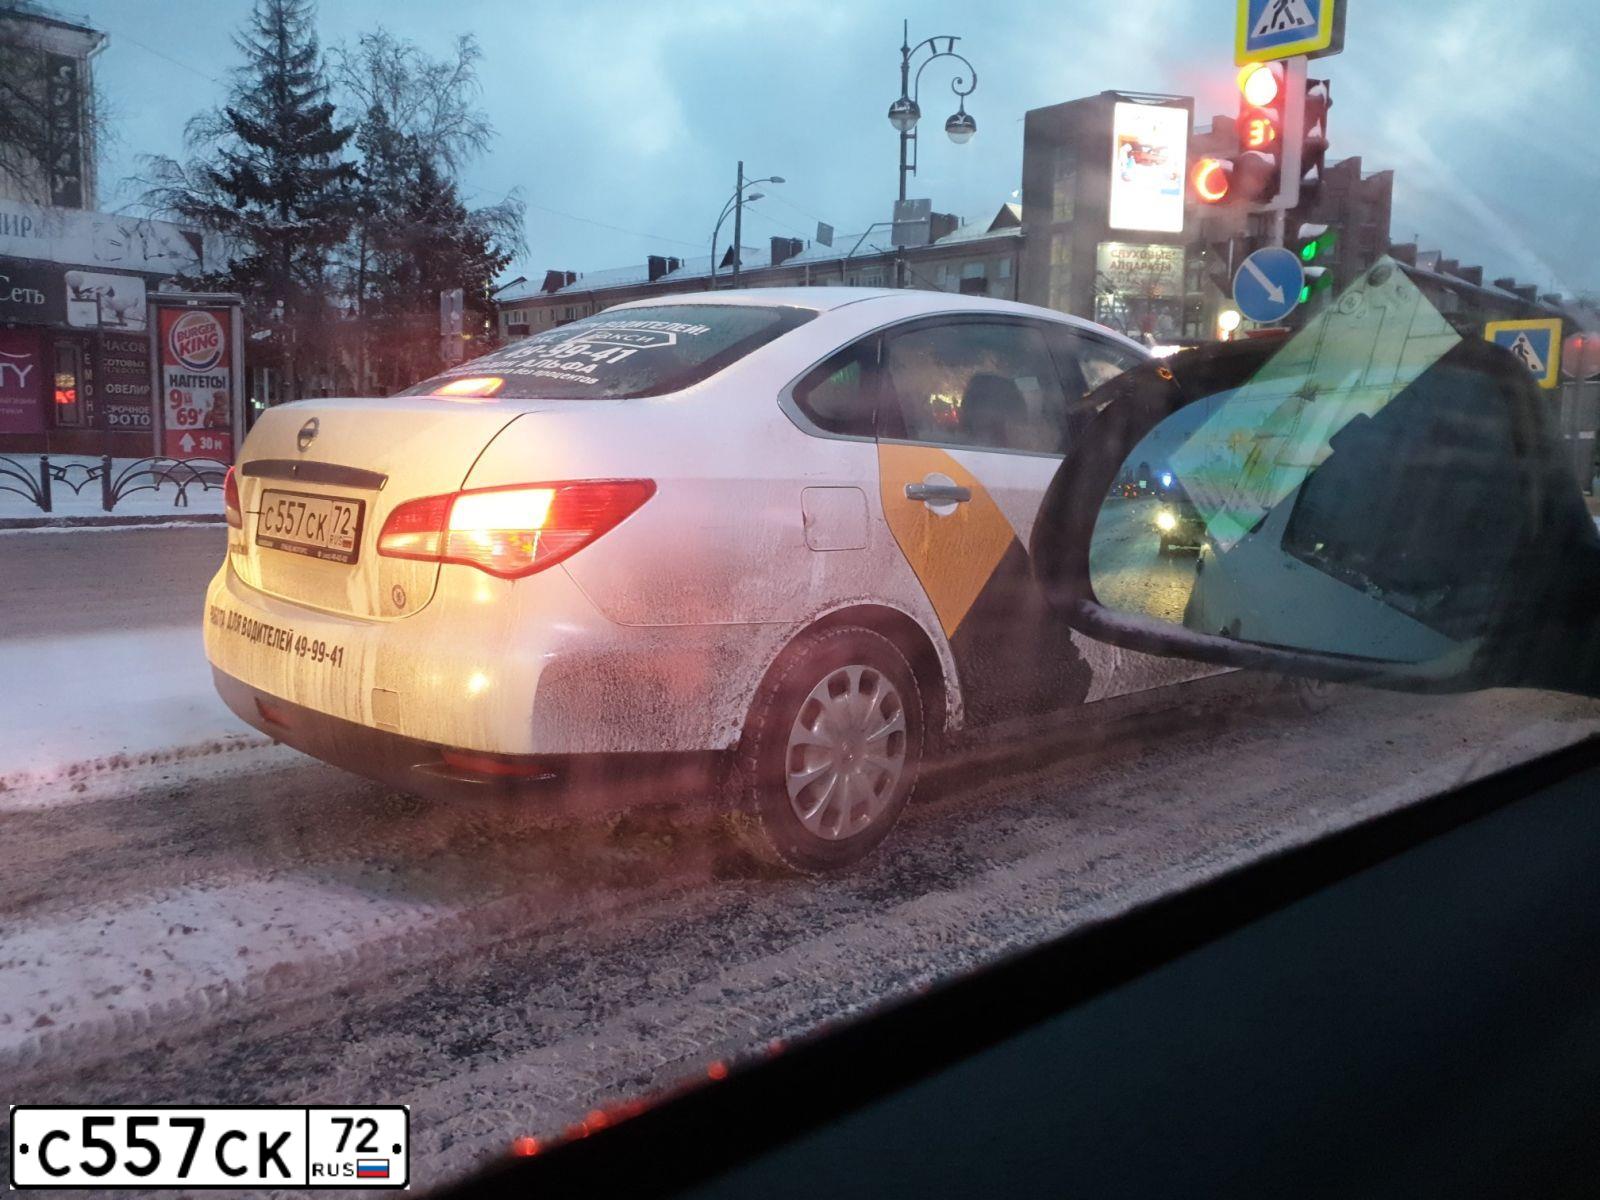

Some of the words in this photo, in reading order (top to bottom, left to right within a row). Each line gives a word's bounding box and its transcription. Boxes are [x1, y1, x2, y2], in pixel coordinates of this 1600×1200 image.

[0, 213, 33, 238] ИР
[177, 322, 217, 343] BURGER
[179, 332, 219, 357] KING
[514, 359, 599, 374] АЛЬФА
[169, 374, 227, 389] НАГГЕТСЫ
[169, 389, 182, 410] 9
[332, 505, 352, 536] 72
[240, 615, 295, 653] ВОДИТЕЛЕЙ
[294, 634, 345, 669] 49-99-41
